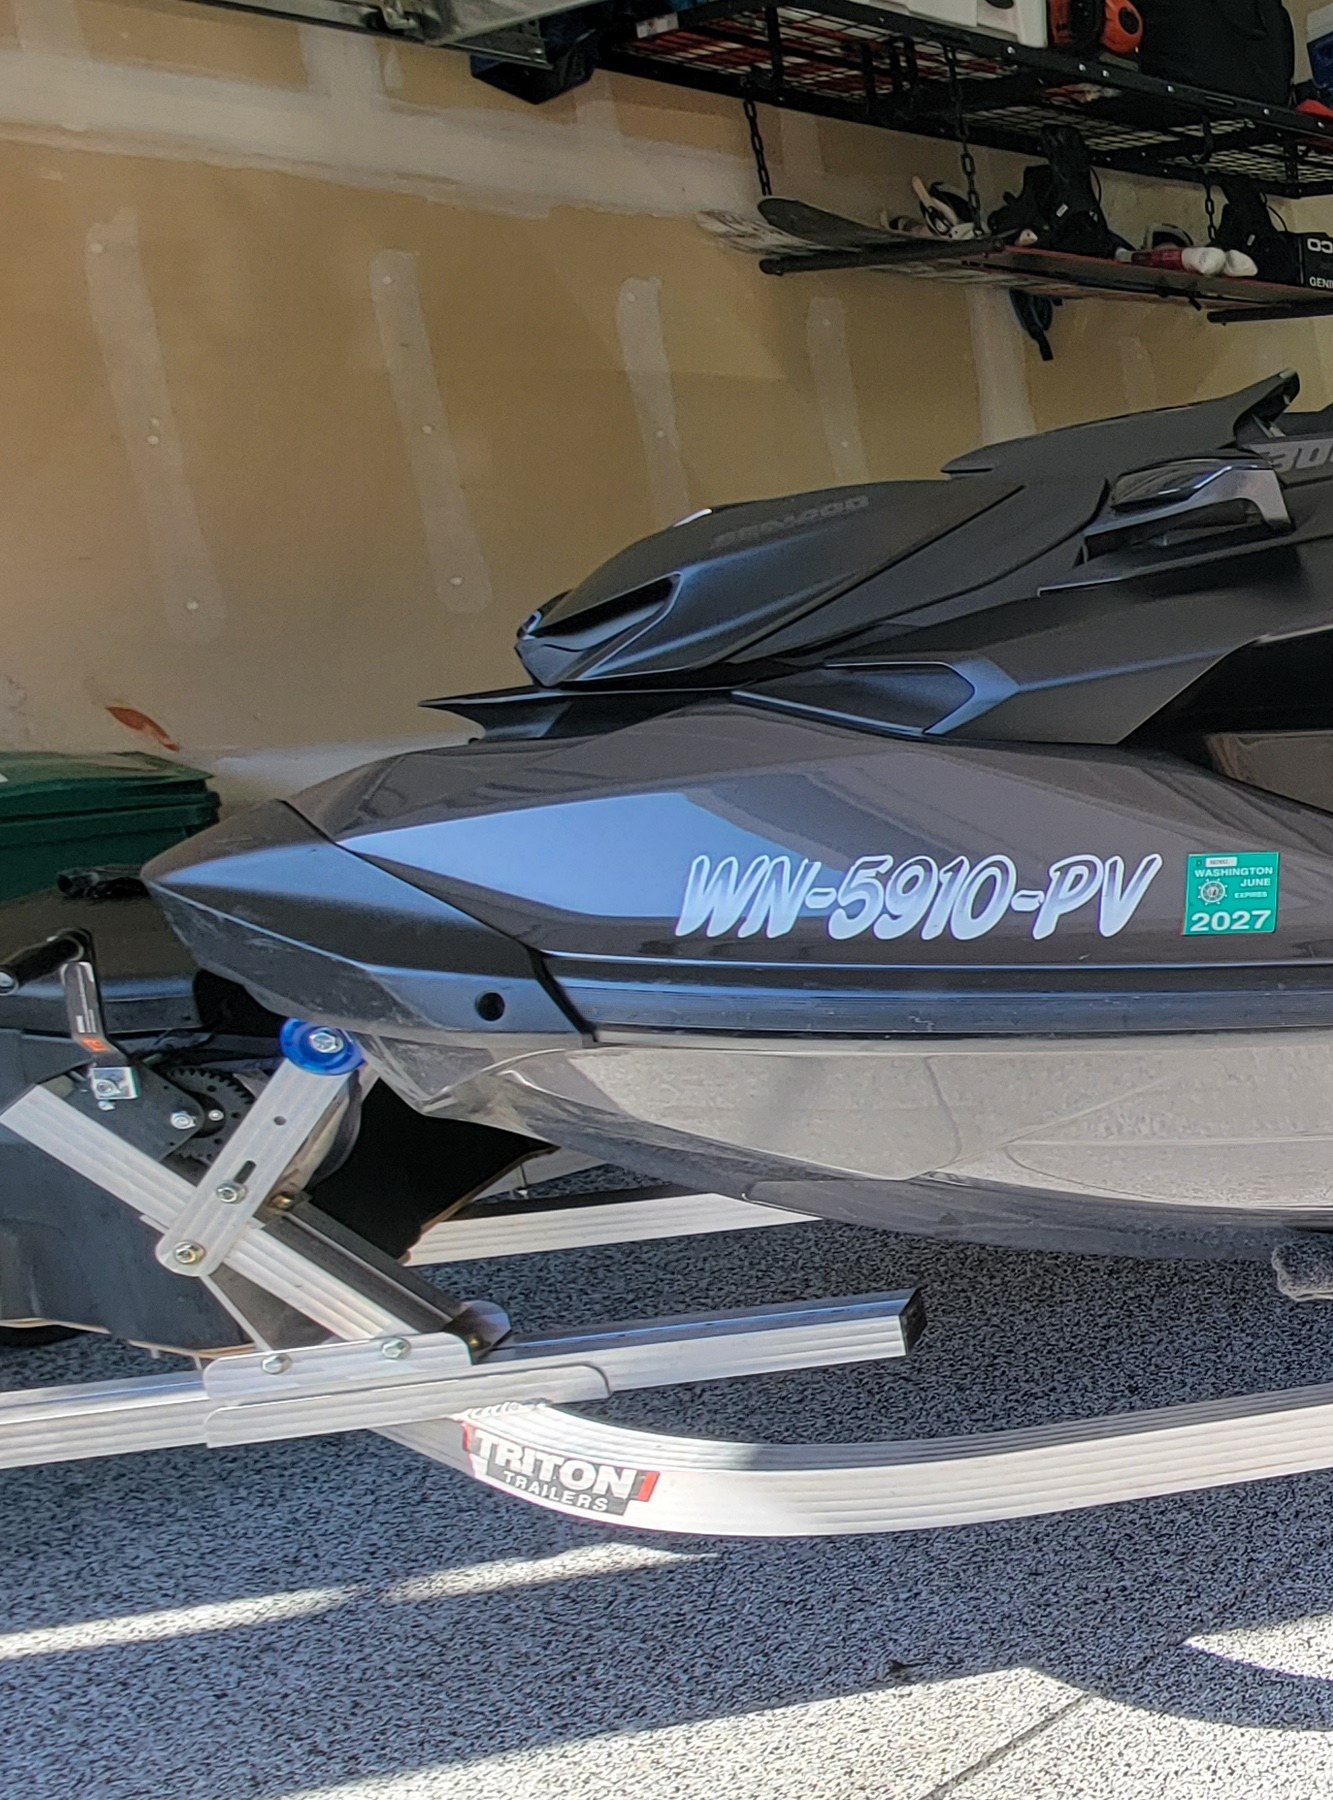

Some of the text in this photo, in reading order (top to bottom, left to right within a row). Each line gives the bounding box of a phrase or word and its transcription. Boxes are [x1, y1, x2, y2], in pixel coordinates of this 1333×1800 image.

[1194, 867, 1273, 878] WASHINGTON
[1240, 878, 1271, 887] JUNE
[675, 854, 1163, 940] WN-5910-PV
[1190, 909, 1271, 931] 2027
[474, 1428, 637, 1500] TRITON
[503, 1470, 608, 1512] TRAILERS
